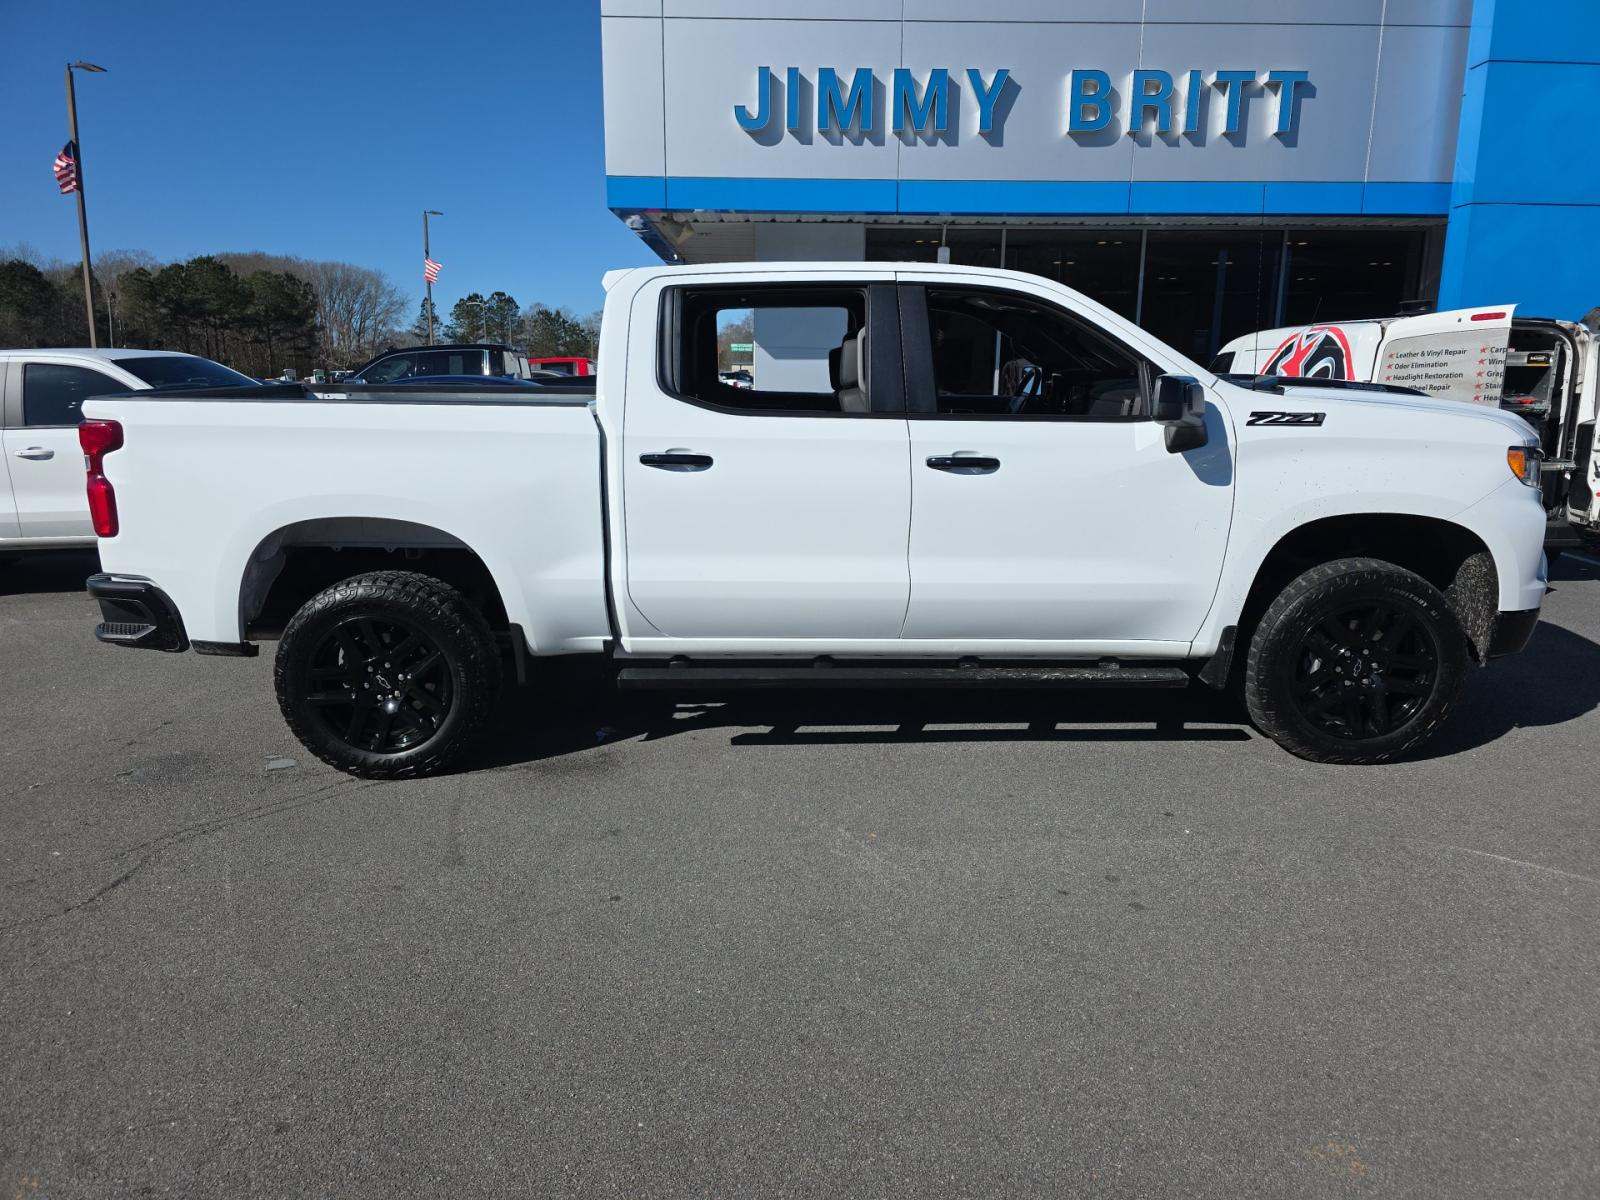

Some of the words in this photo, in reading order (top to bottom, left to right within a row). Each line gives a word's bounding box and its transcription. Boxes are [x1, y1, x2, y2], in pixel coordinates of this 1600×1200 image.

[734, 66, 1010, 134] JIMMY
[1068, 69, 1309, 135] BRITT
[1396, 351, 1419, 359] Leather
[1426, 349, 1443, 358] Vinyl
[1444, 348, 1467, 356] Repair
[1411, 361, 1448, 369] Elimination
[1393, 373, 1423, 381] Headlight
[1424, 372, 1464, 380] Restoration
[1428, 384, 1451, 392] Repair
[1246, 411, 1326, 427] Z71
